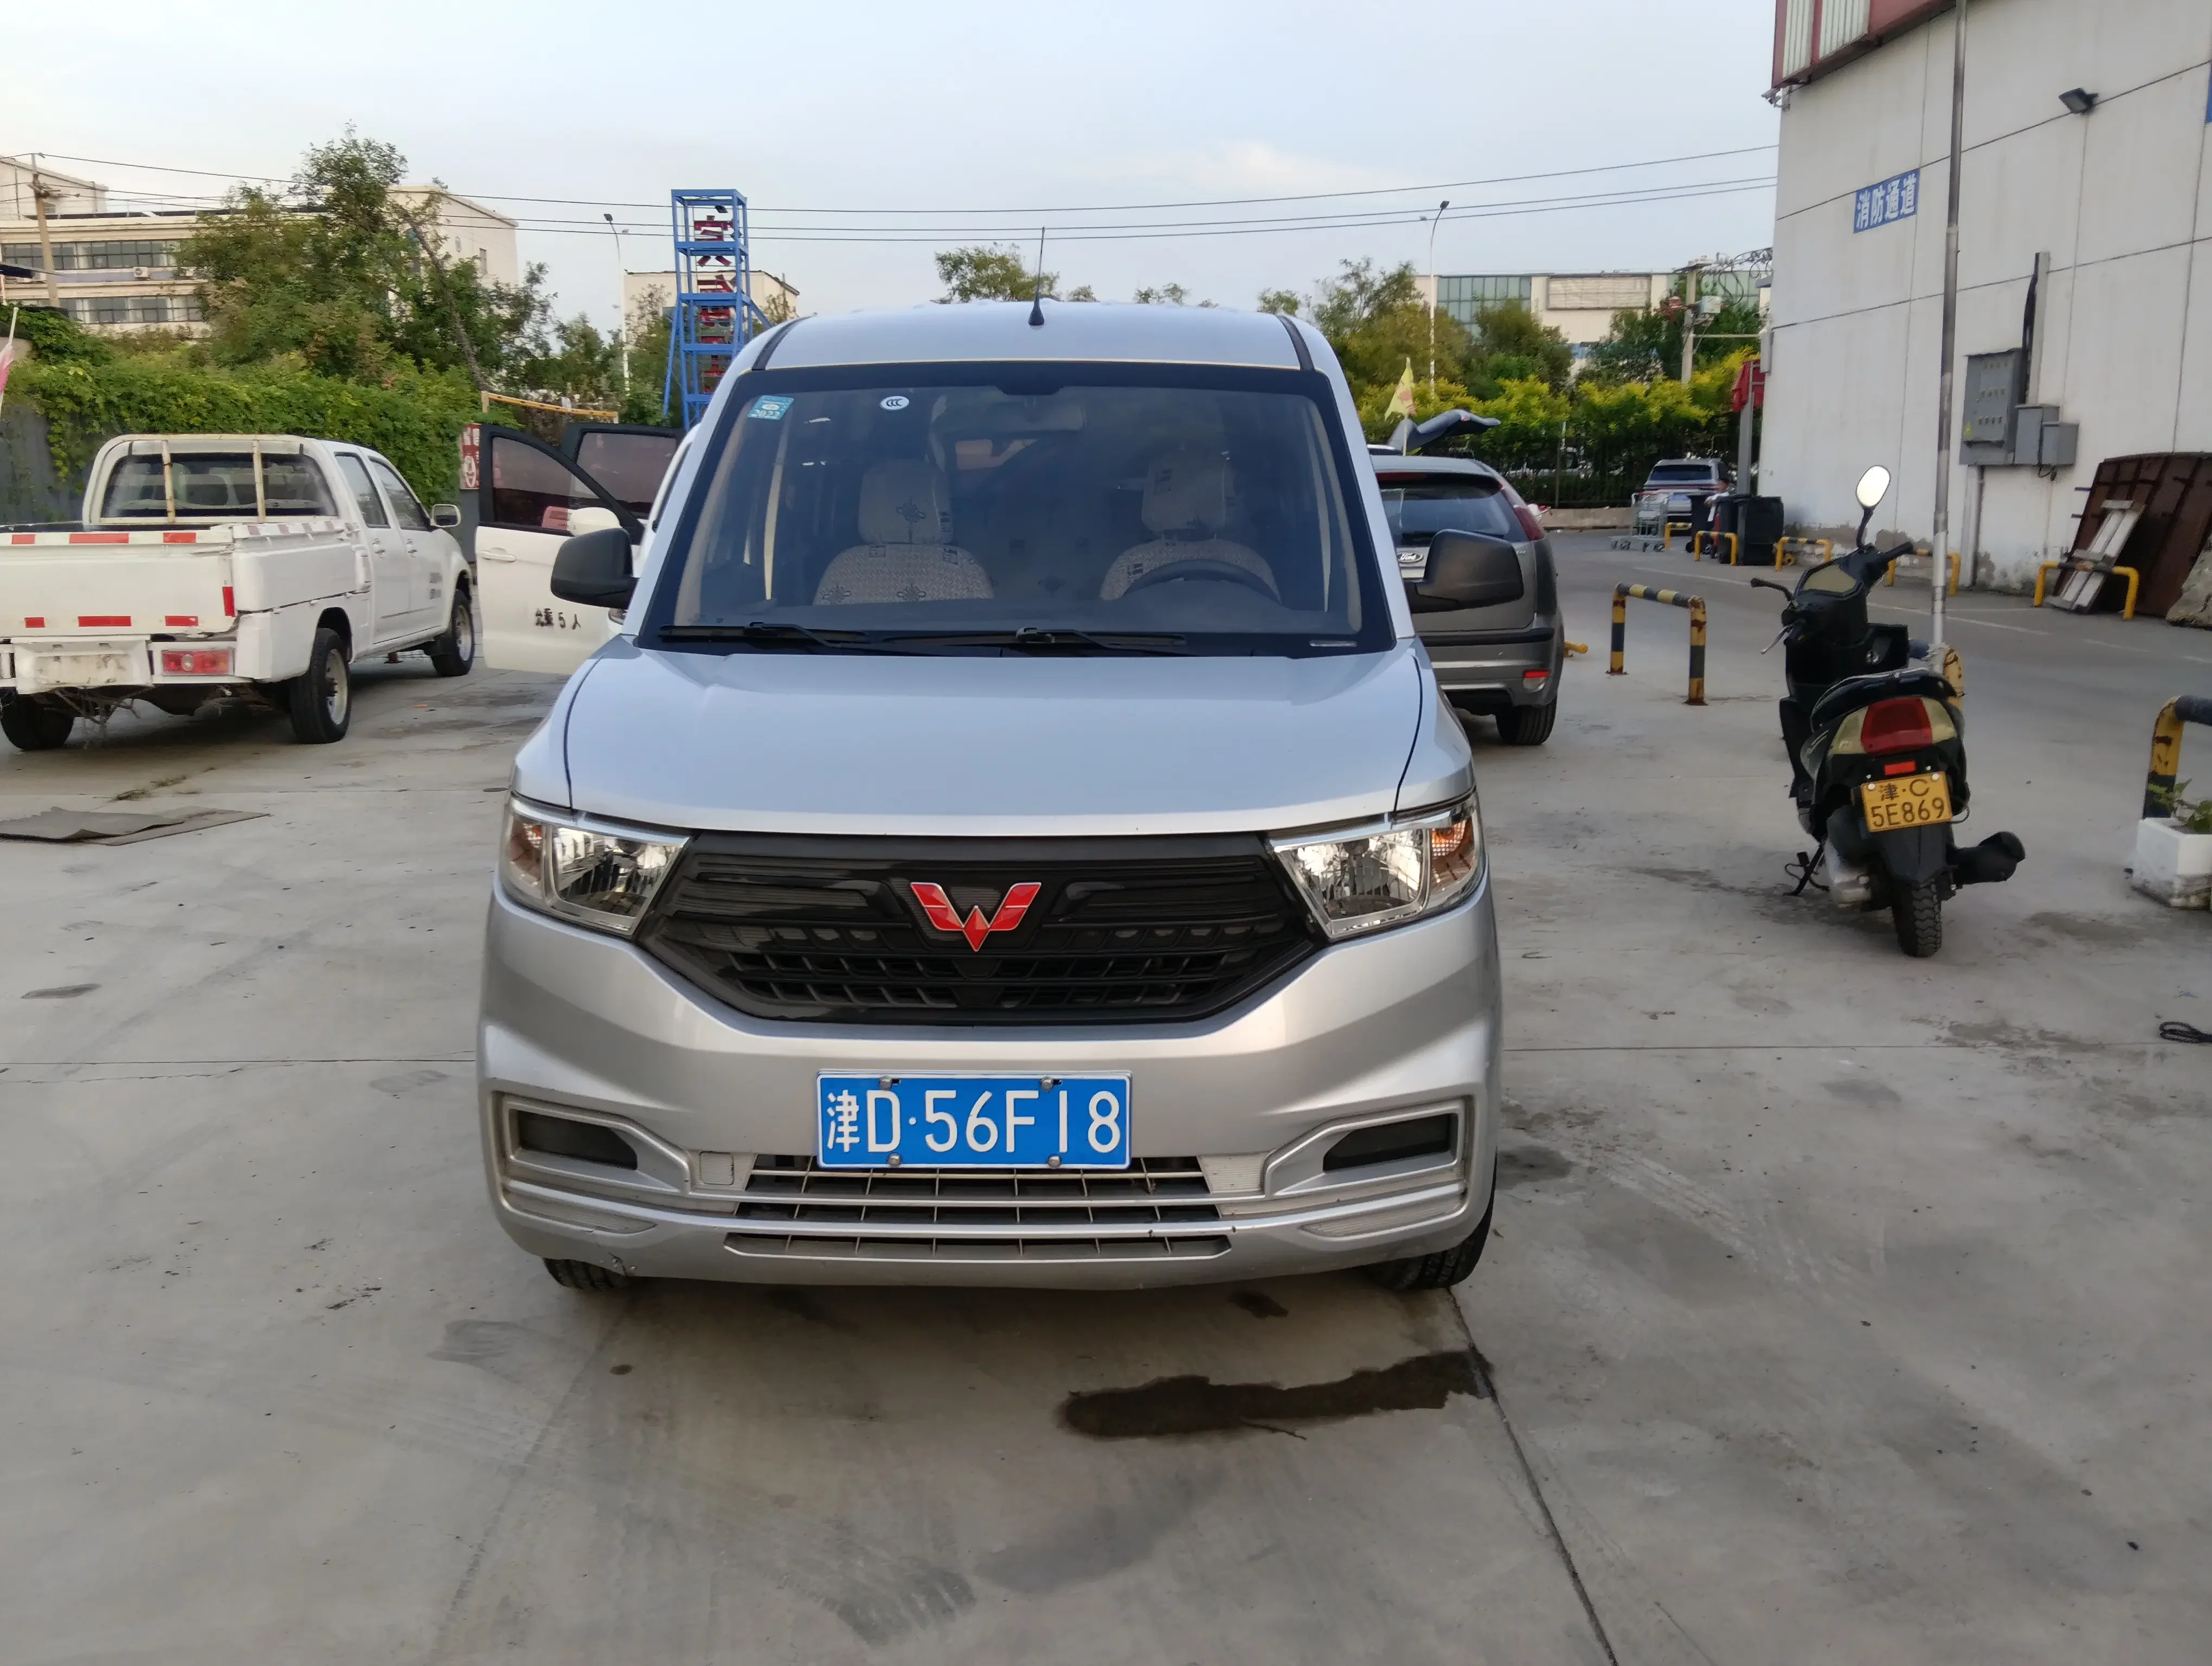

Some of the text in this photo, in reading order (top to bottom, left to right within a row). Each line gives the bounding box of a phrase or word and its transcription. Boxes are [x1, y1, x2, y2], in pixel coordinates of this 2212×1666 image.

[1856, 173, 1917, 229] 消防通道
[1871, 797, 1945, 827] 5E869
